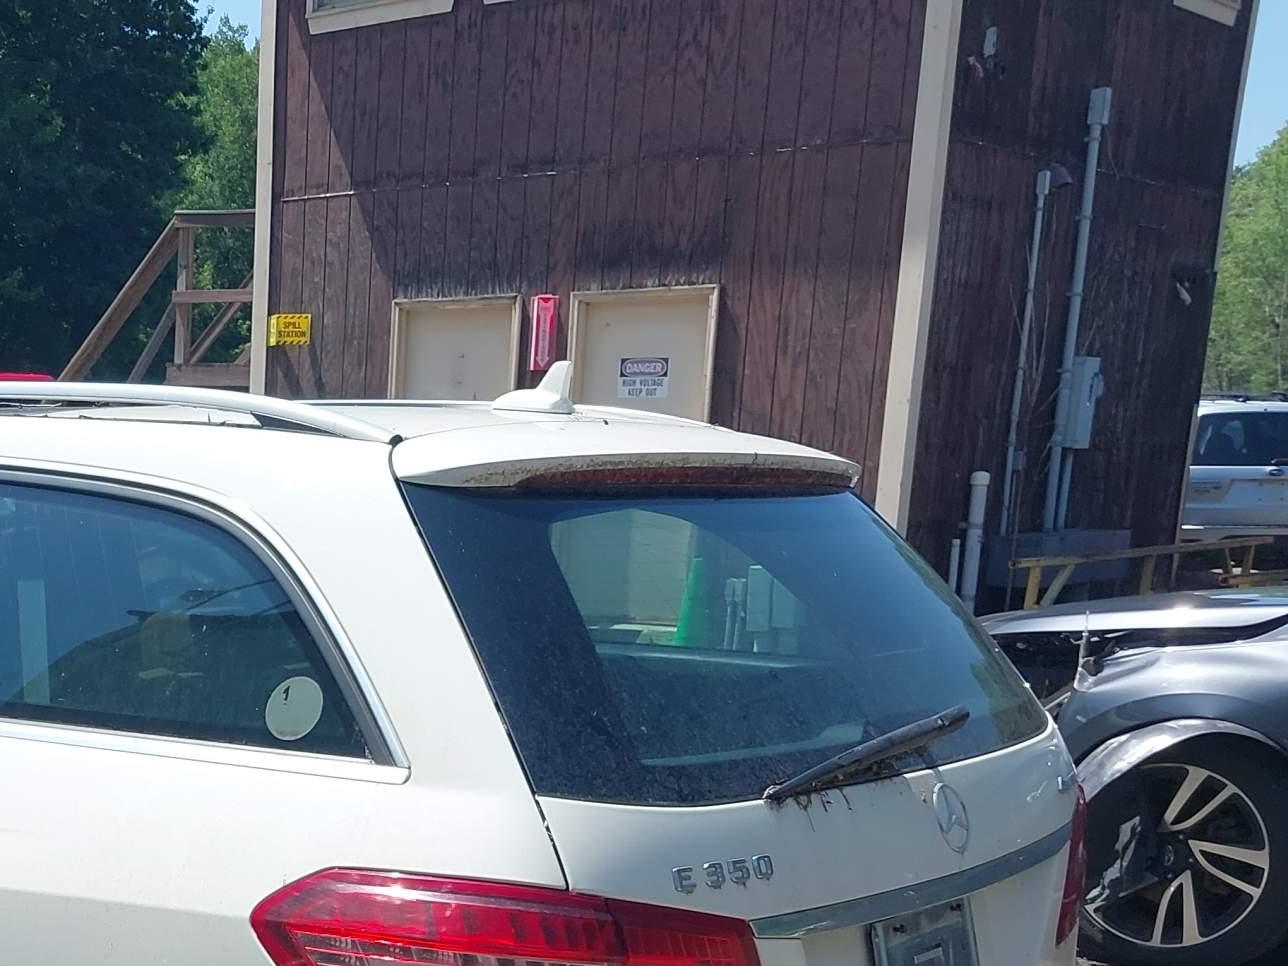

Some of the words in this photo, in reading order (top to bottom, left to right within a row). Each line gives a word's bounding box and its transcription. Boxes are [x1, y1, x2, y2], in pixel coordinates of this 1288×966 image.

[283, 321, 302, 329] SPILL
[278, 330, 306, 338] STATION
[626, 363, 663, 373] DANGER
[622, 379, 637, 387] HIGH
[639, 378, 665, 387] VOLTAGE
[627, 388, 642, 397] KEEP
[645, 388, 657, 397] OUT
[703, 854, 774, 889] 350
